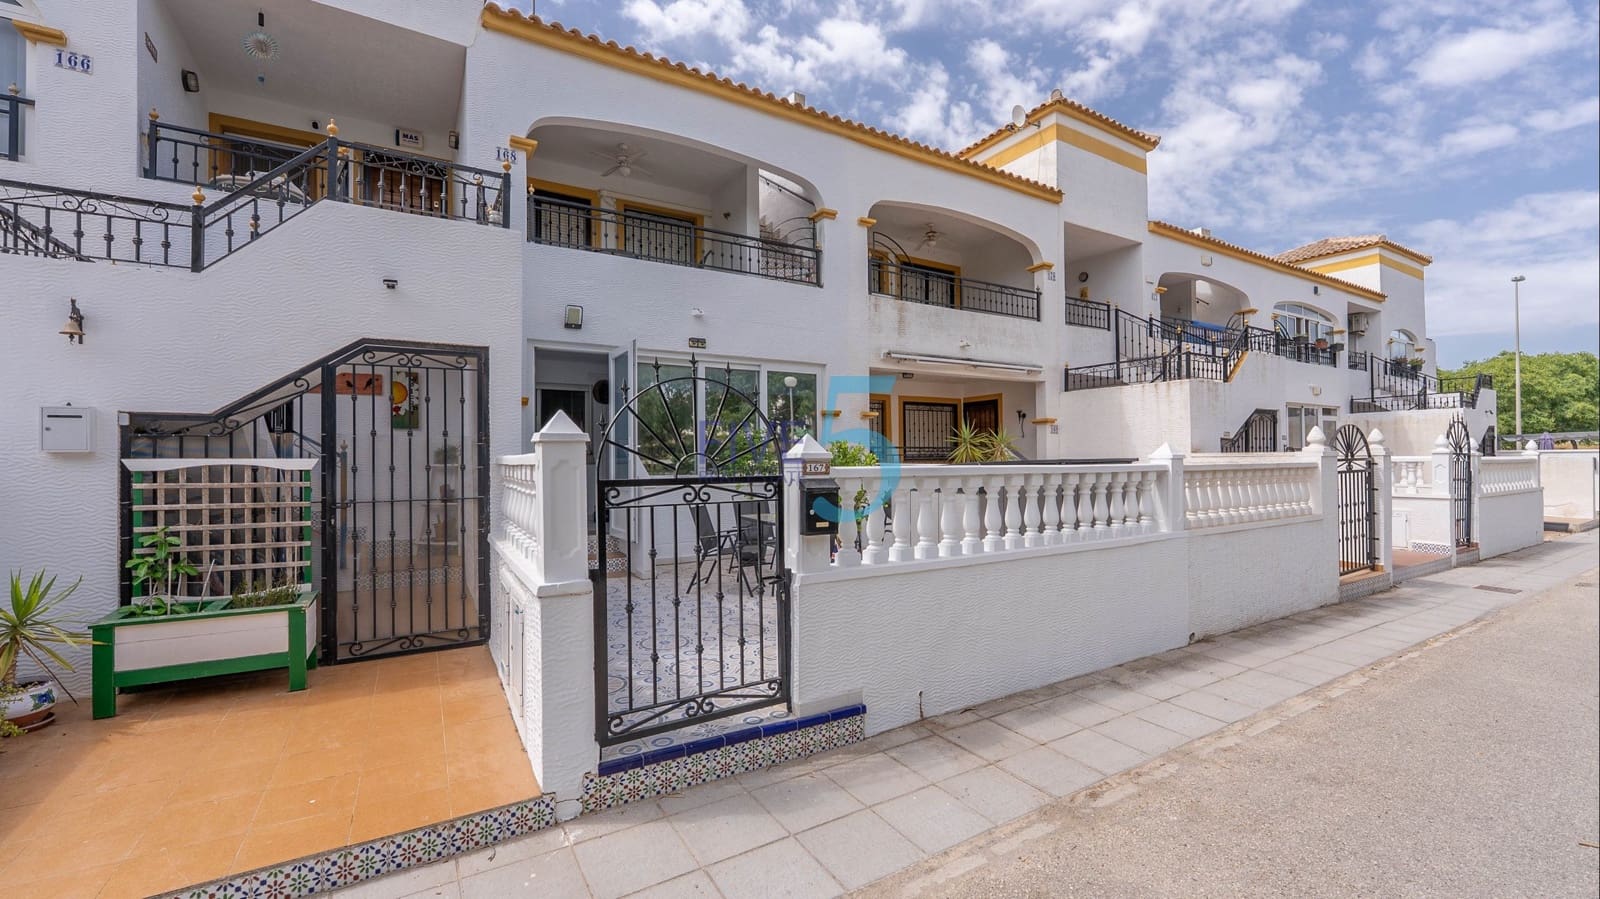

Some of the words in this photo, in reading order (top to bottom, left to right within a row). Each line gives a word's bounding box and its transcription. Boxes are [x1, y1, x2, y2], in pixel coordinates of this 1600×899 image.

[55, 51, 91, 71] 166
[496, 148, 516, 161] 168
[808, 463, 824, 472] 167
